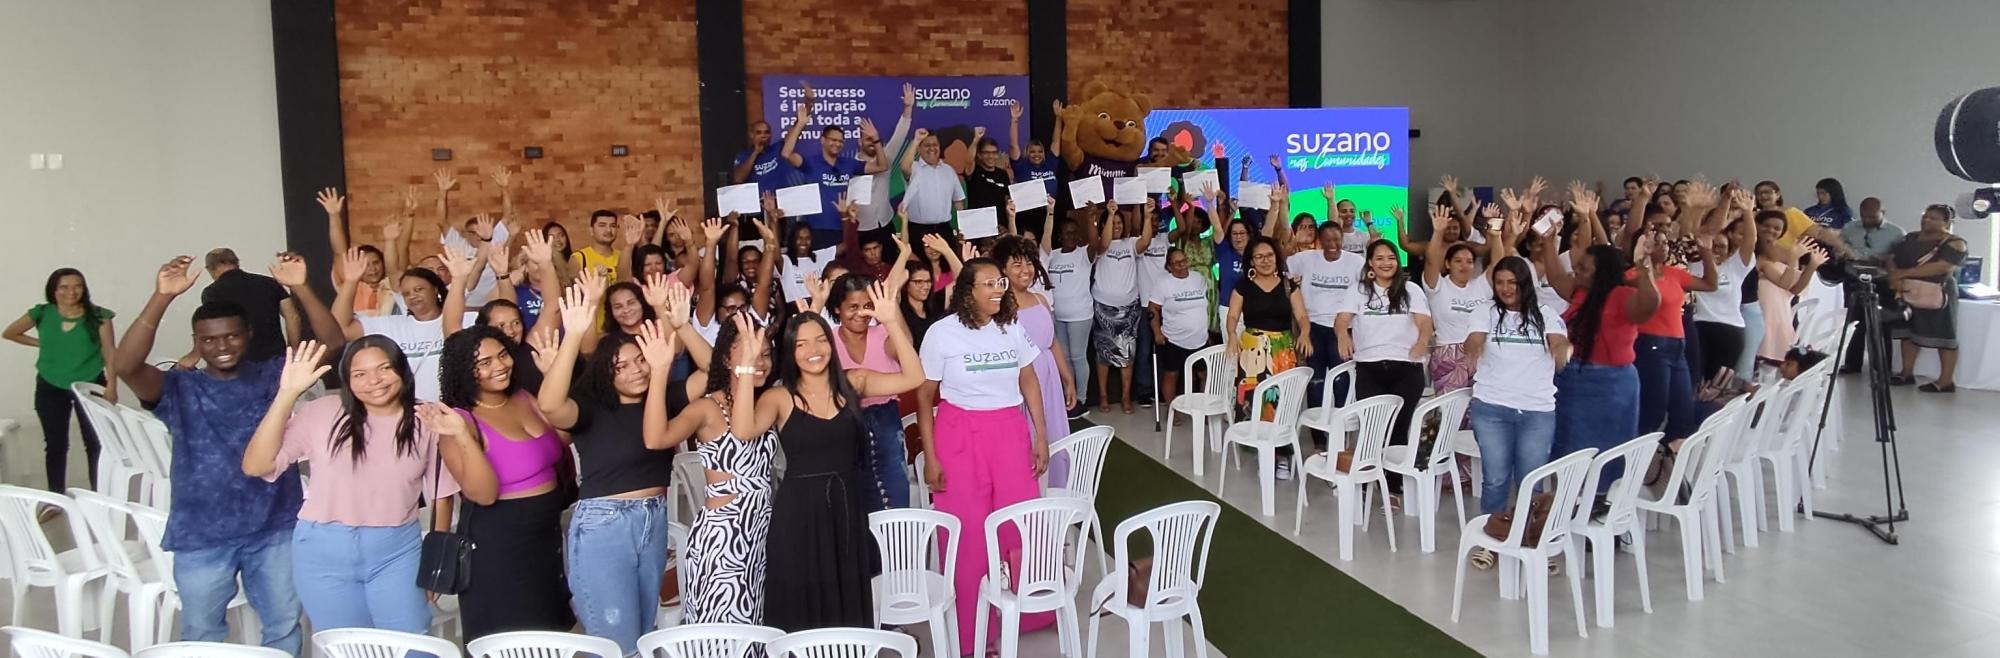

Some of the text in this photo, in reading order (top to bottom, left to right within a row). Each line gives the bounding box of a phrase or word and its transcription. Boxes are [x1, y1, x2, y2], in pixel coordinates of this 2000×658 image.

[915, 88, 970, 100] suzano
[780, 100, 789, 112] é
[781, 115, 813, 129] paa
[816, 114, 851, 126] toda
[1286, 132, 1391, 154] suzano
[1312, 272, 1350, 284] suzano
[963, 349, 1017, 363] suzano
